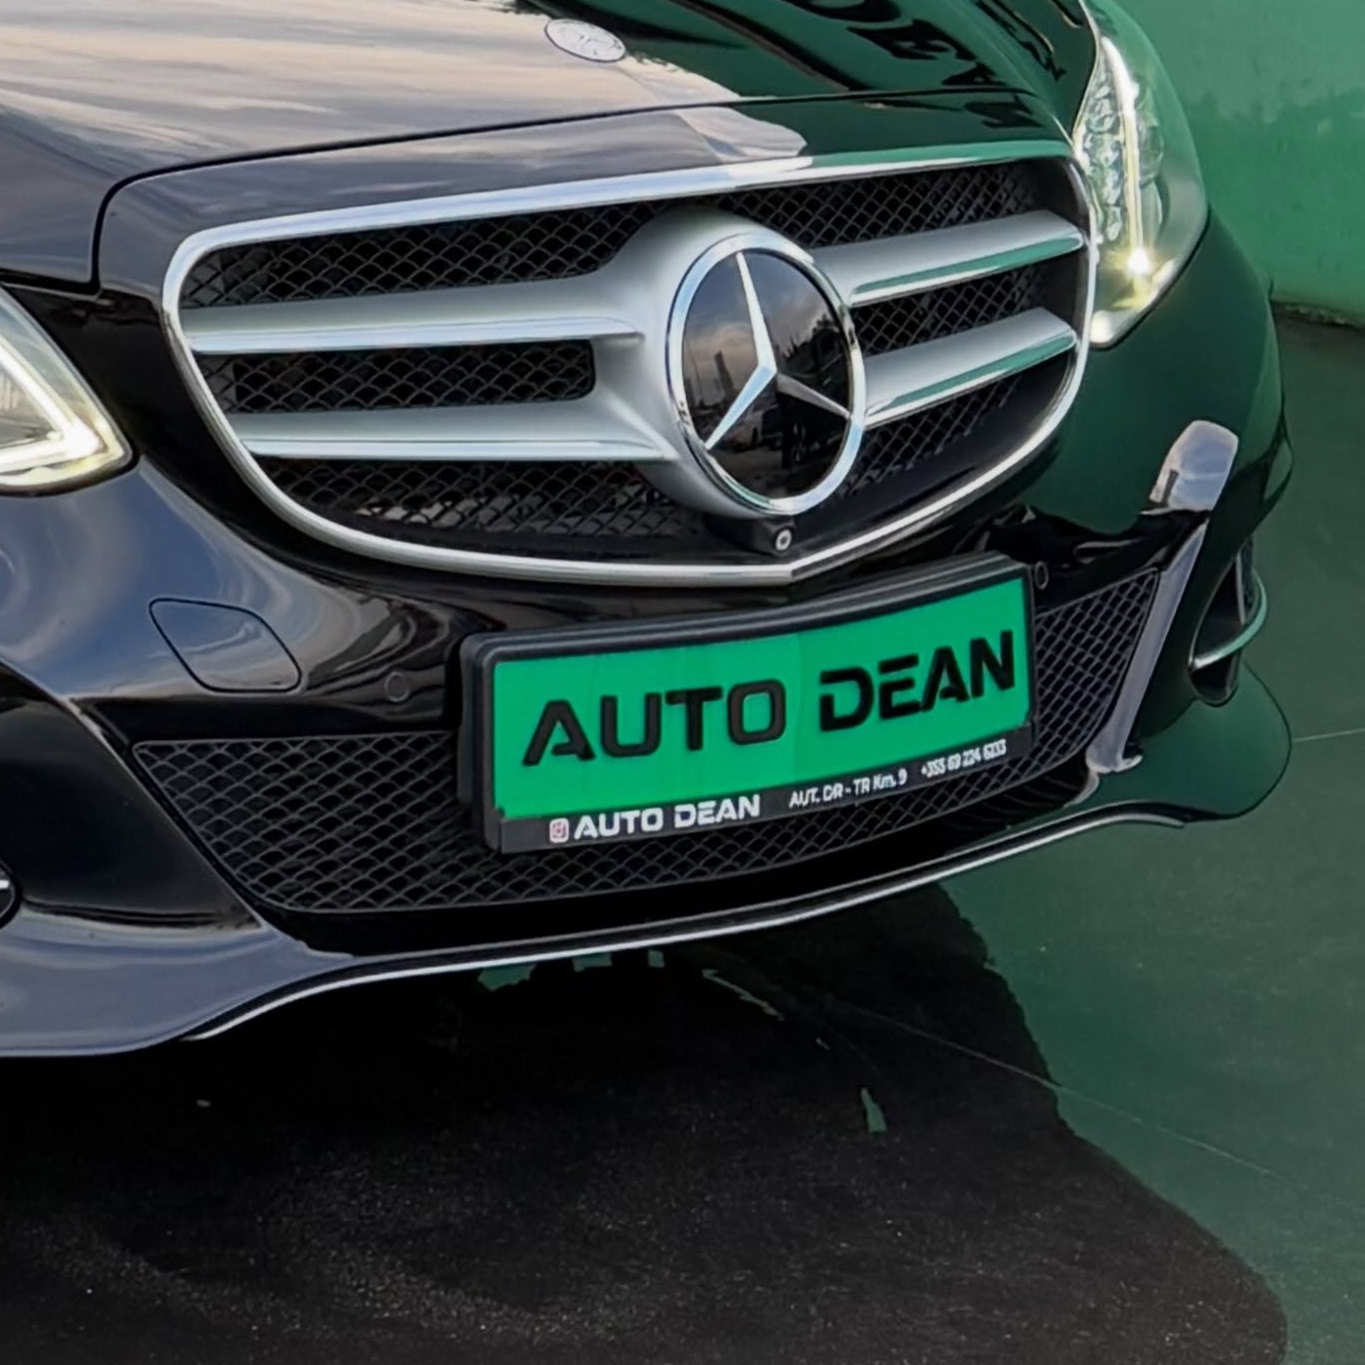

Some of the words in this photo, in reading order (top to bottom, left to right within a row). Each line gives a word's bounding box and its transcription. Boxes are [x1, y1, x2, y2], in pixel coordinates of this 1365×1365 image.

[523, 679, 786, 766] AUTO
[819, 629, 1014, 732] DEAN
[574, 807, 664, 840] AUTO
[673, 793, 761, 829] DEAN
[789, 787, 821, 809] AUT.
[853, 777, 871, 796] TR
